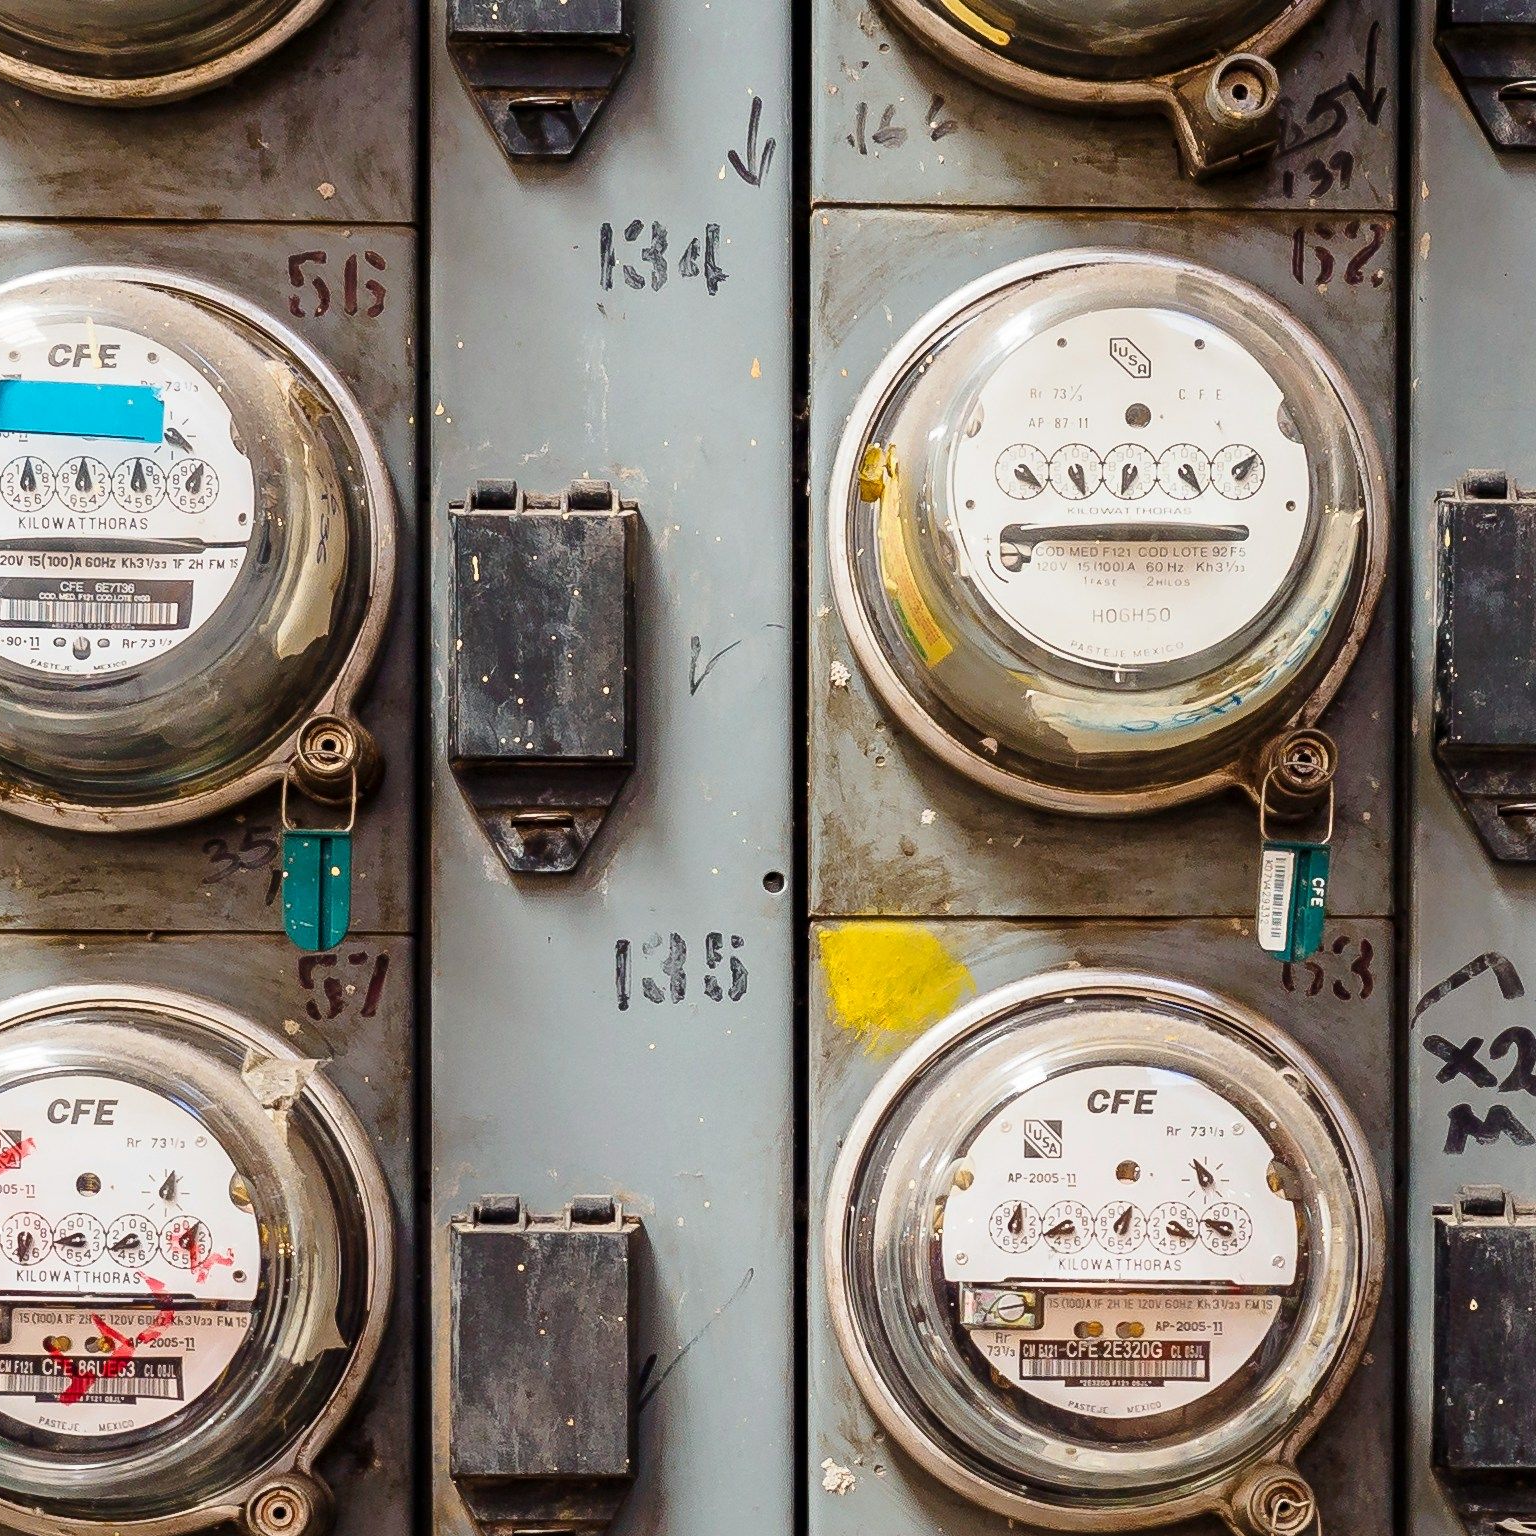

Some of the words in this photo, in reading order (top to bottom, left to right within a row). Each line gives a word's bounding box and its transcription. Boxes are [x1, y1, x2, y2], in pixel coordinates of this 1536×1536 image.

[600, 219, 728, 294] 134
[47, 344, 120, 368] CFE
[1113, 342, 1148, 375] IUSA
[18, 517, 149, 530] KILOWATTHORAS
[1173, 547, 1208, 557] LOTE
[1091, 607, 1171, 624] H06H50
[1311, 877, 1325, 908] CFE
[615, 932, 748, 1011] 135
[297, 952, 389, 1020] 57
[47, 1098, 118, 1126] CFE
[1087, 1088, 1157, 1115] CFE
[1027, 1123, 1060, 1157] IUSA
[16, 1269, 141, 1286] KILOWATTHORAS
[1057, 1257, 1183, 1273] KILOWATTHORAS
[1066, 1340, 1098, 1358] CFE
[41, 1358, 73, 1376] CFE
